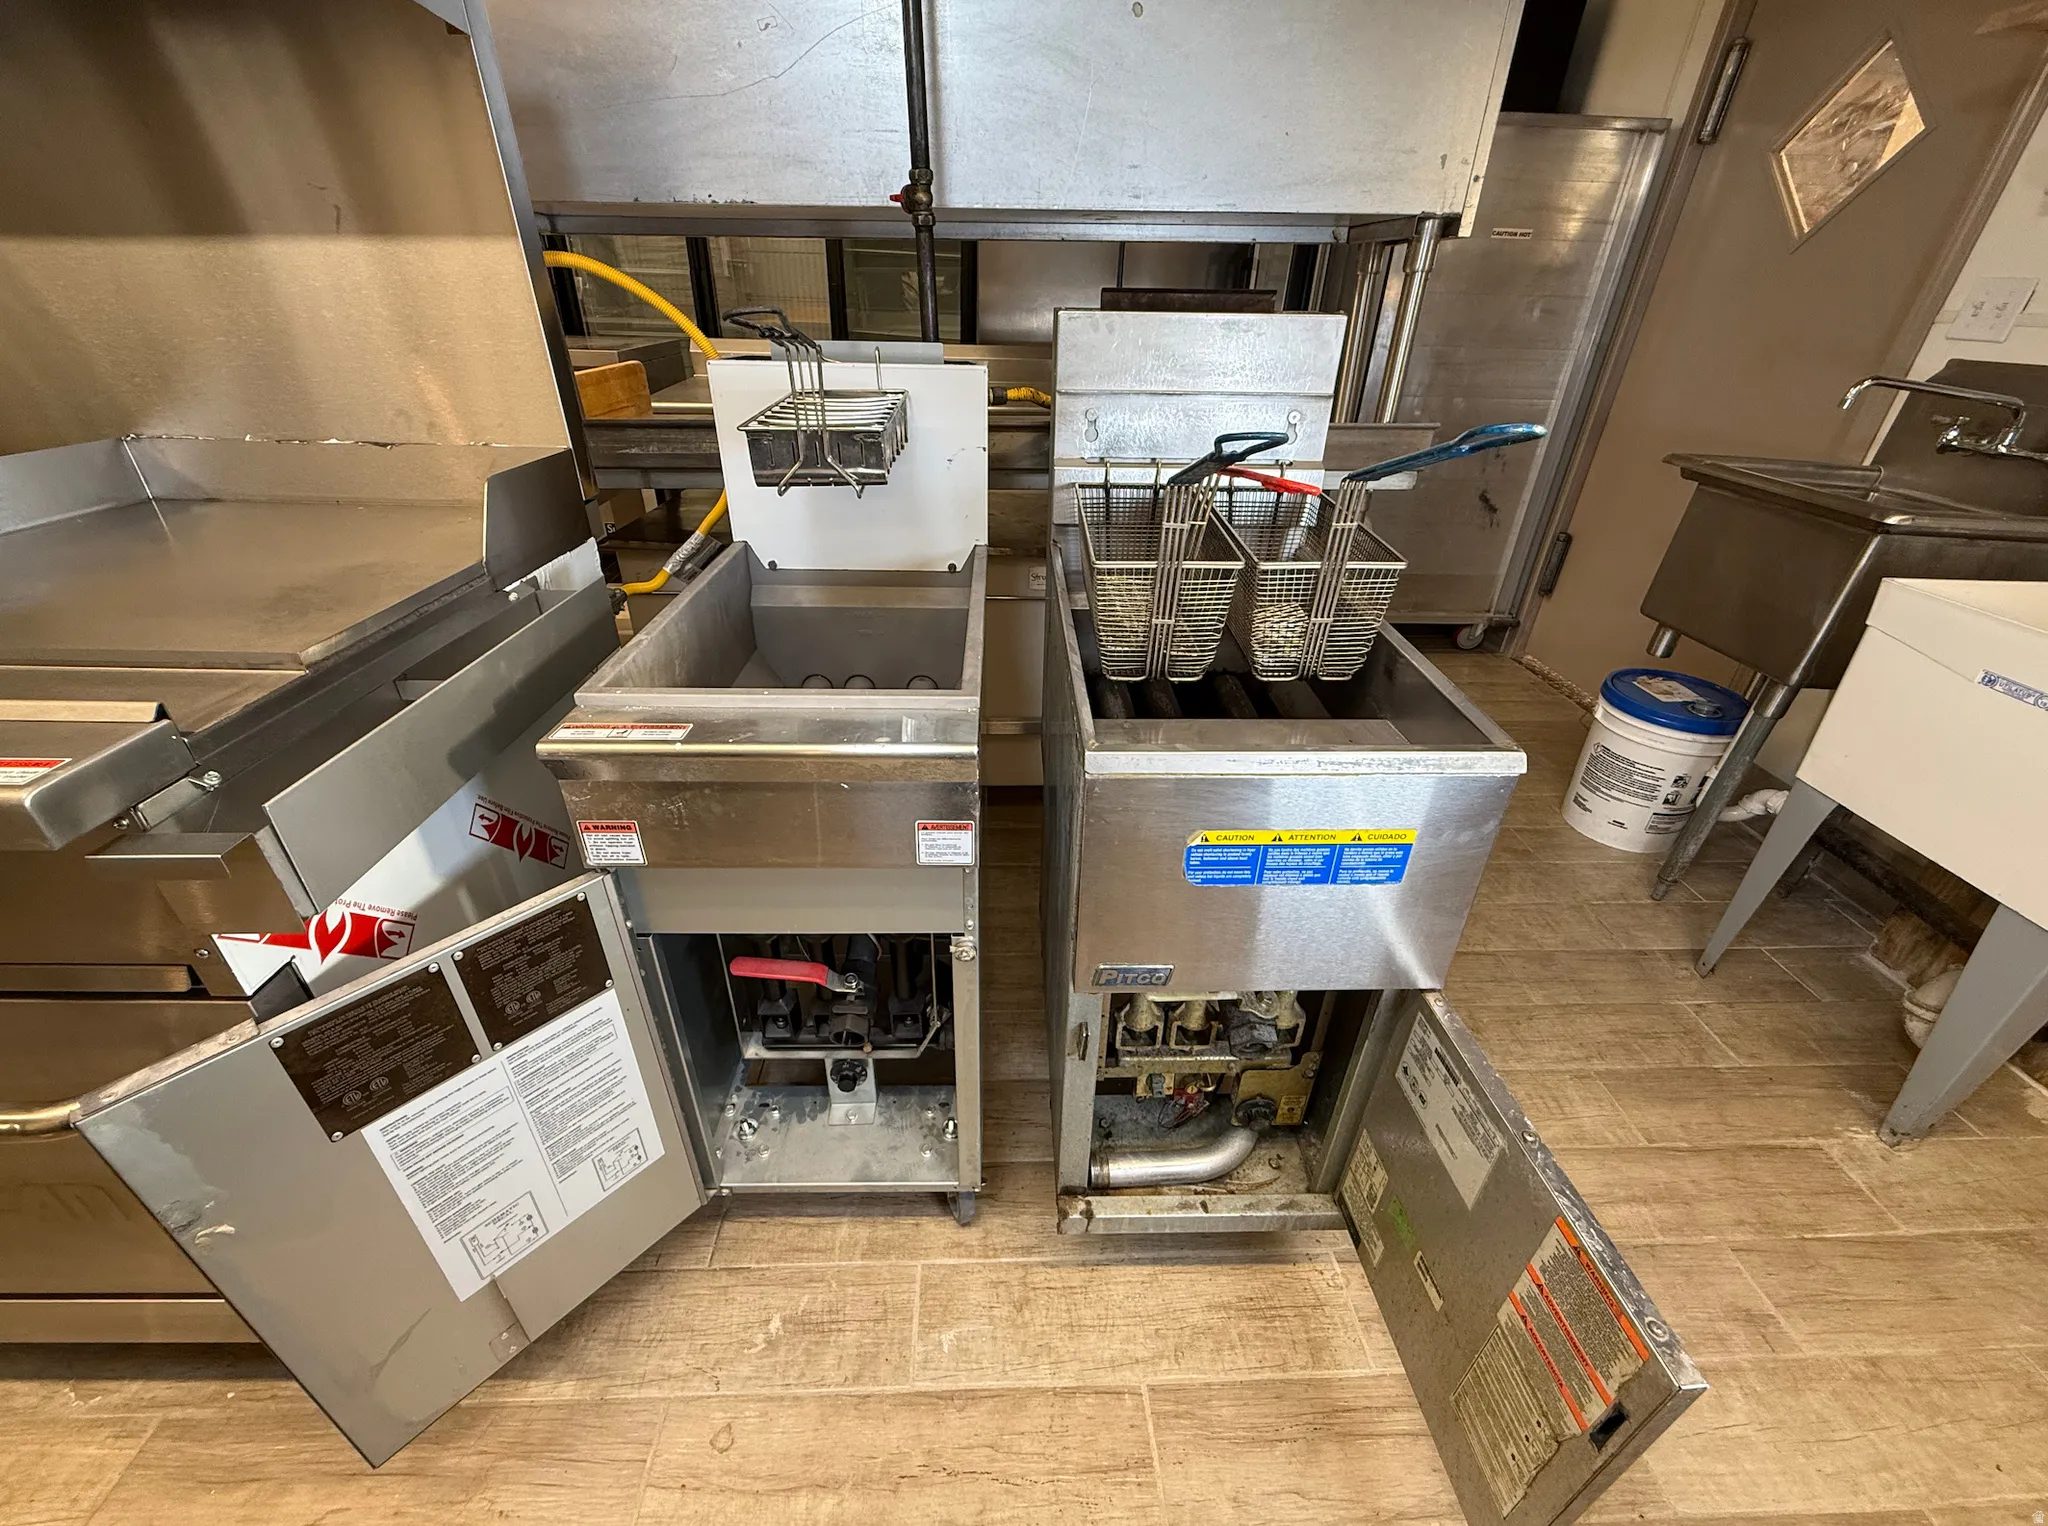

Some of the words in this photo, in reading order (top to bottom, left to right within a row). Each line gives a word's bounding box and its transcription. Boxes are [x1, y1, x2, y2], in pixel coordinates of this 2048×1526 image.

[477, 794, 488, 804] Use
[488, 798, 504, 811] Before
[353, 901, 366, 911] The
[368, 903, 396, 917] Remove
[397, 911, 418, 921] Please
[1585, 1261, 1615, 1307] WARNING
